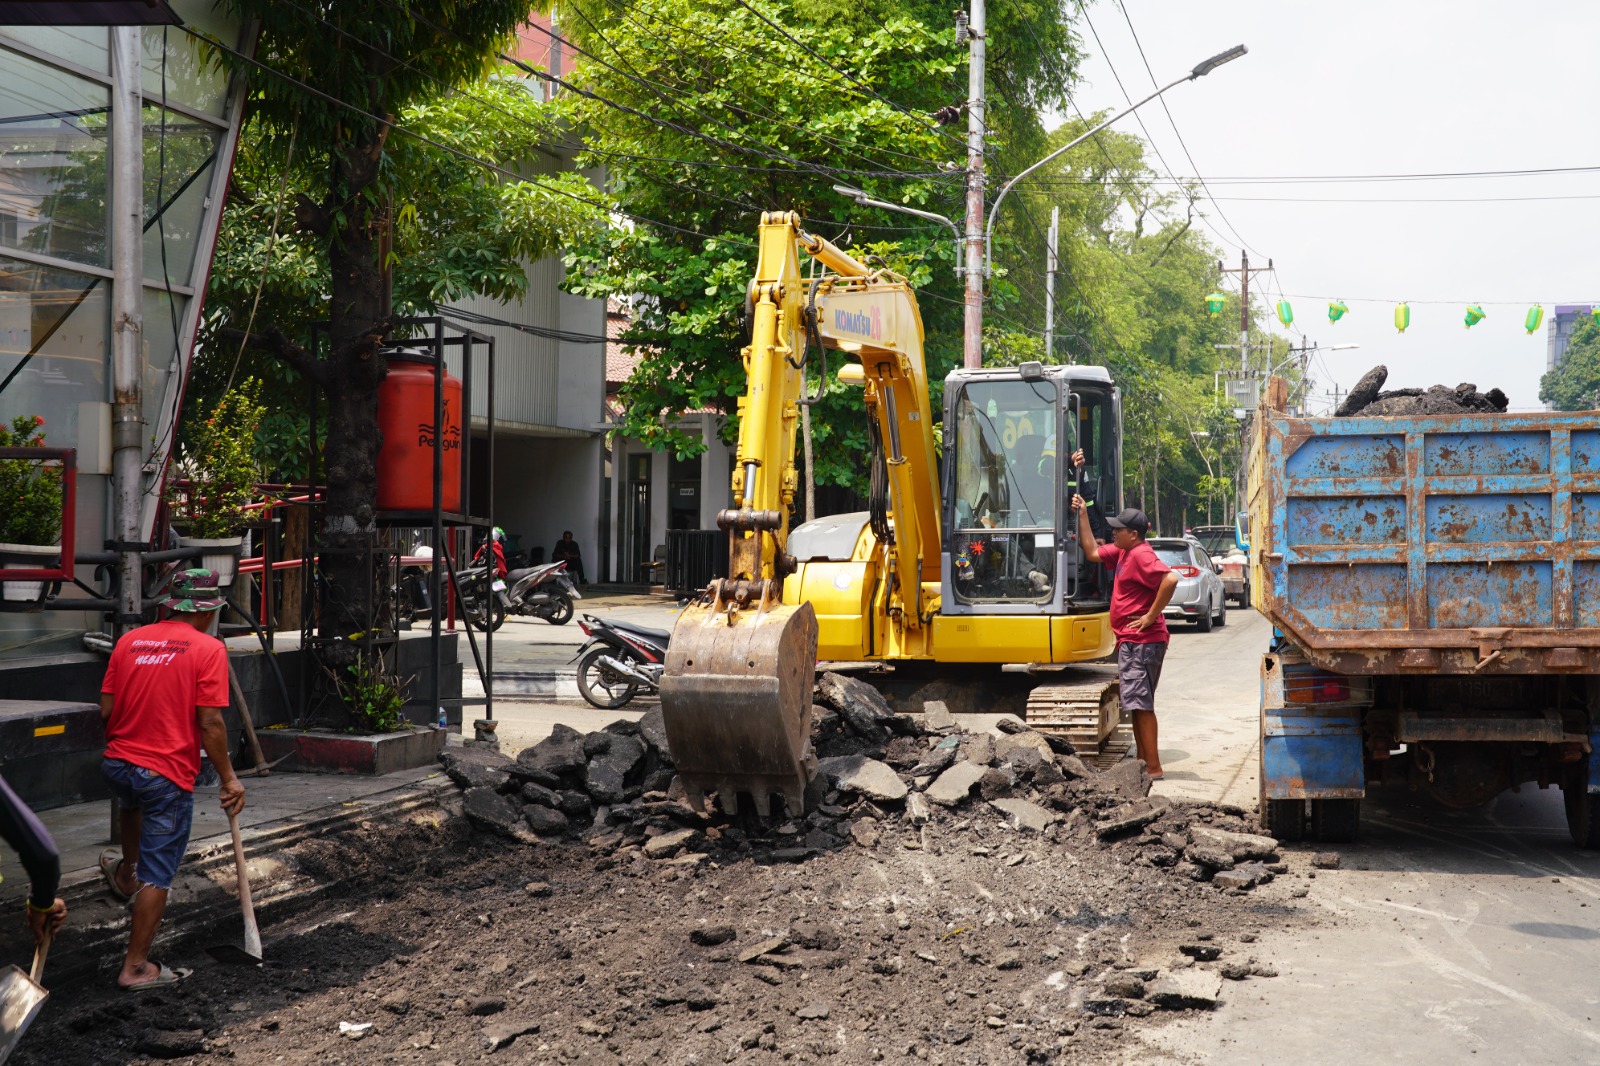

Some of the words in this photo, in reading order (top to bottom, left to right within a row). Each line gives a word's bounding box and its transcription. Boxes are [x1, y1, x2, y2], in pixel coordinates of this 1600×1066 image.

[835, 309, 869, 336] KOMATSU
[419, 435, 461, 450] Peguin
[135, 652, 176, 665] HEBAT!
